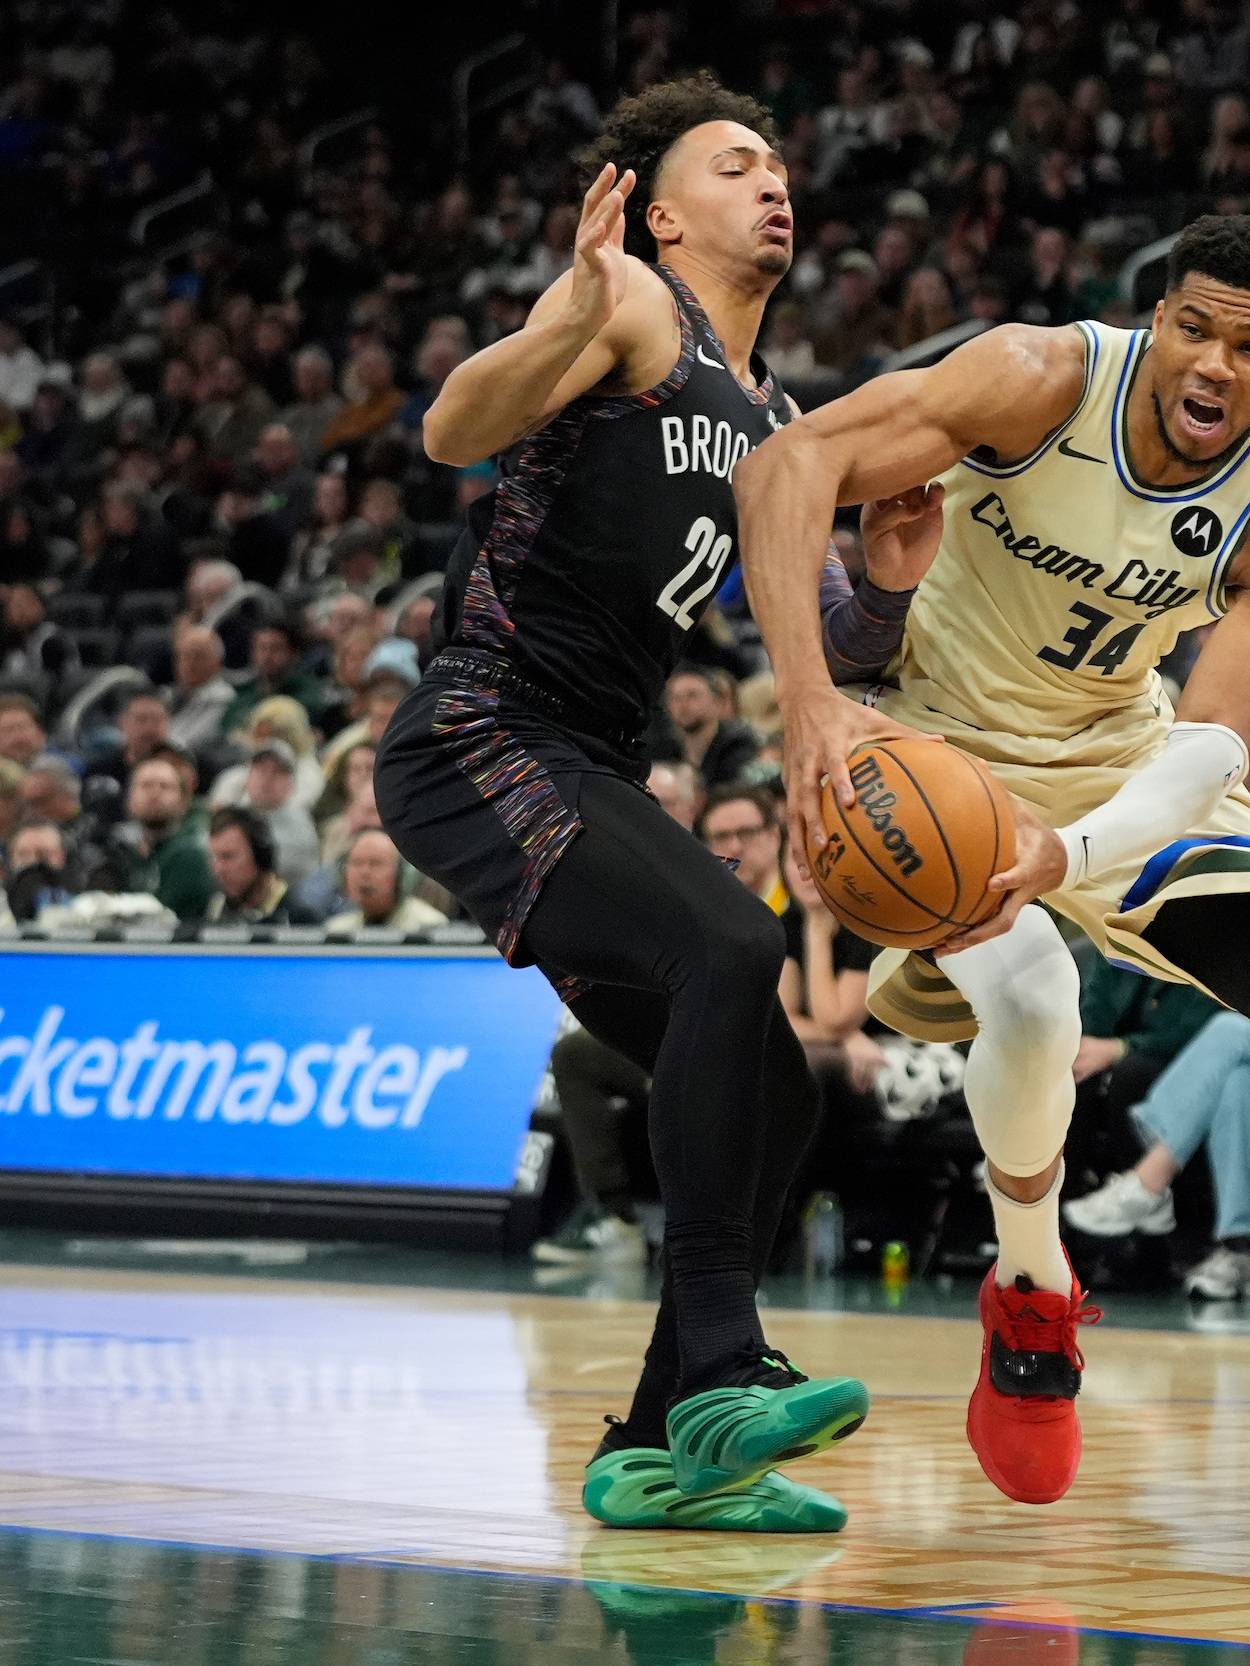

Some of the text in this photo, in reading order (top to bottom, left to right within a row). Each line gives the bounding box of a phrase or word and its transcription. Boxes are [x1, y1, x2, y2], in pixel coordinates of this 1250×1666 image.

[661, 414, 756, 485] BROO
[656, 516, 732, 632] 22
[970, 492, 1200, 621] Cream City
[1036, 601, 1148, 676] 34
[850, 754, 924, 878] Wilson
[0, 1004, 469, 1129] cketmaster
